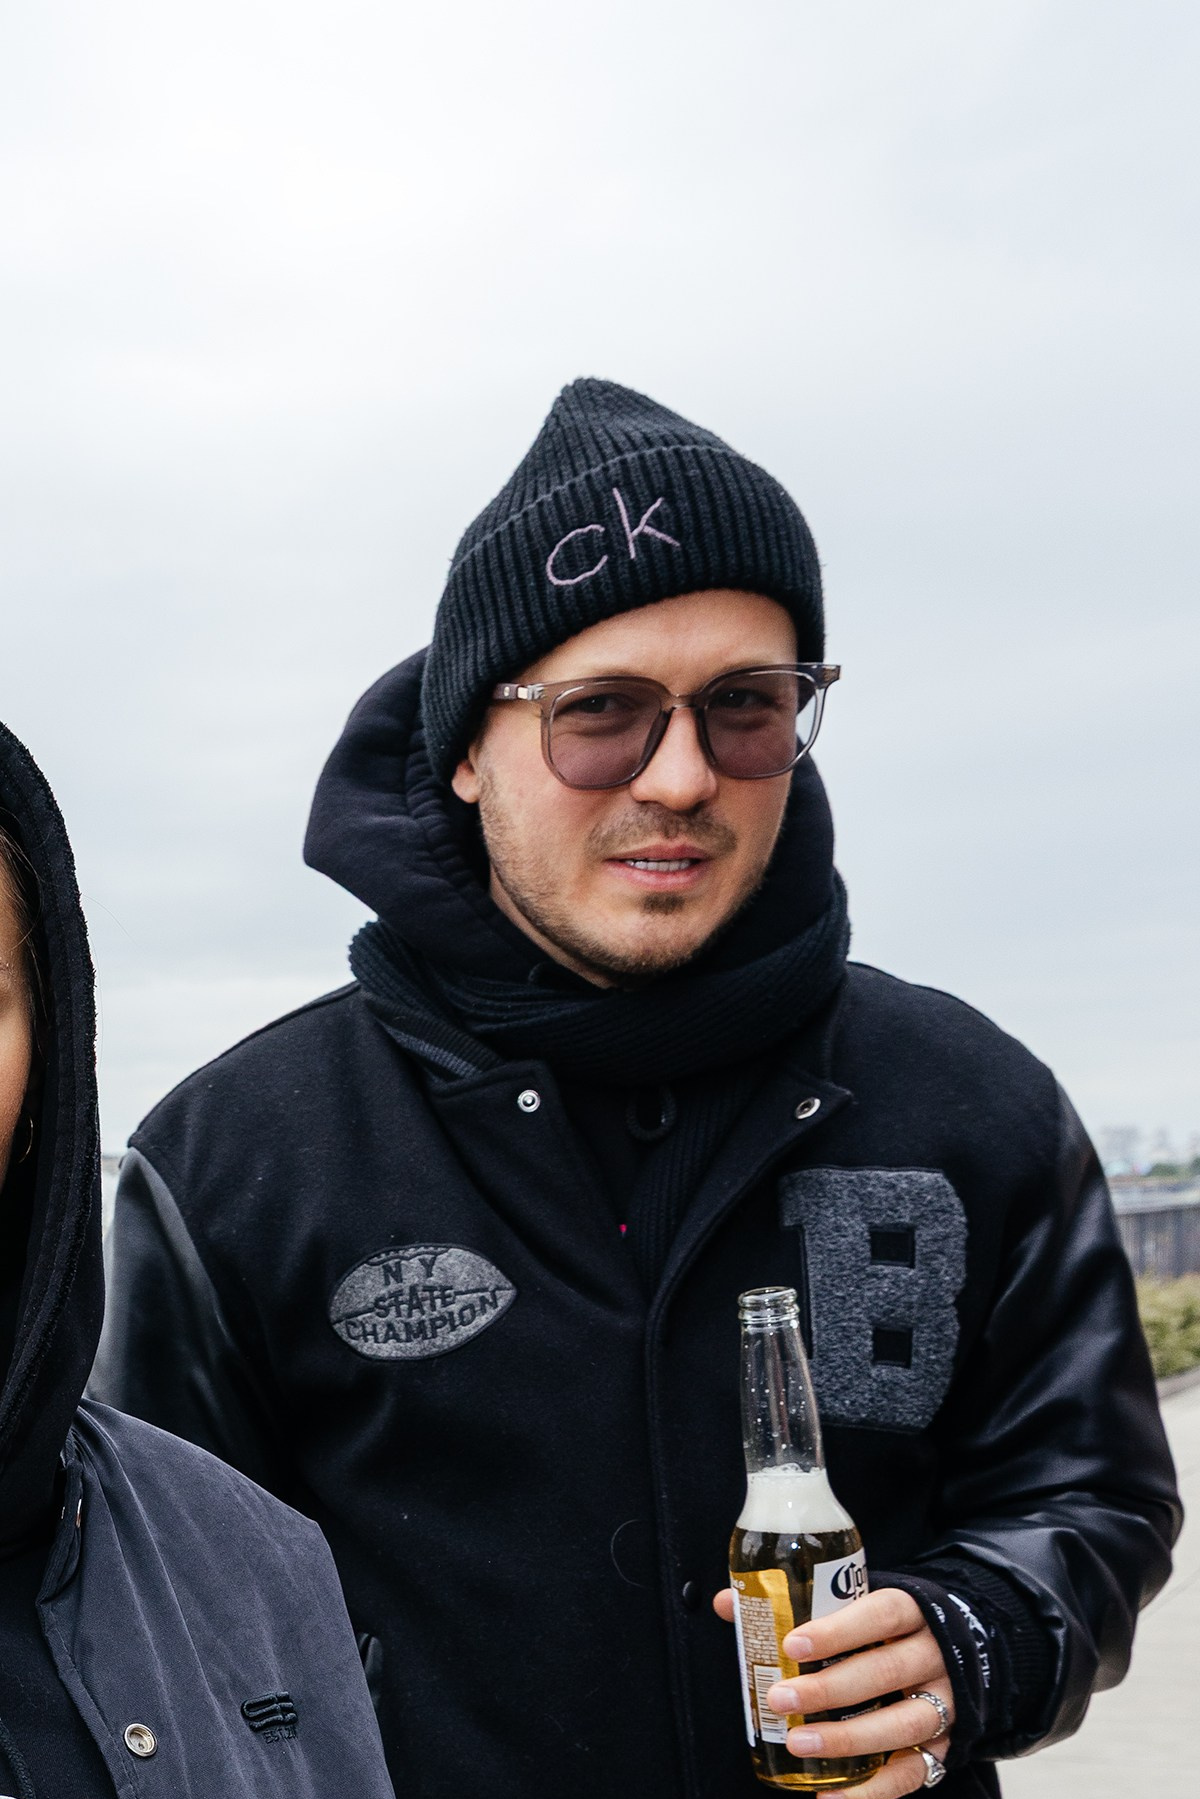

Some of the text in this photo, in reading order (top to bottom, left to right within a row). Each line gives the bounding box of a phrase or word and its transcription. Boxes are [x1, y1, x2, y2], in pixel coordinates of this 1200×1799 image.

[345, 1287, 499, 1344] CHAMPION
[374, 1283, 456, 1319] STATE
[778, 1167, 968, 1431] B
